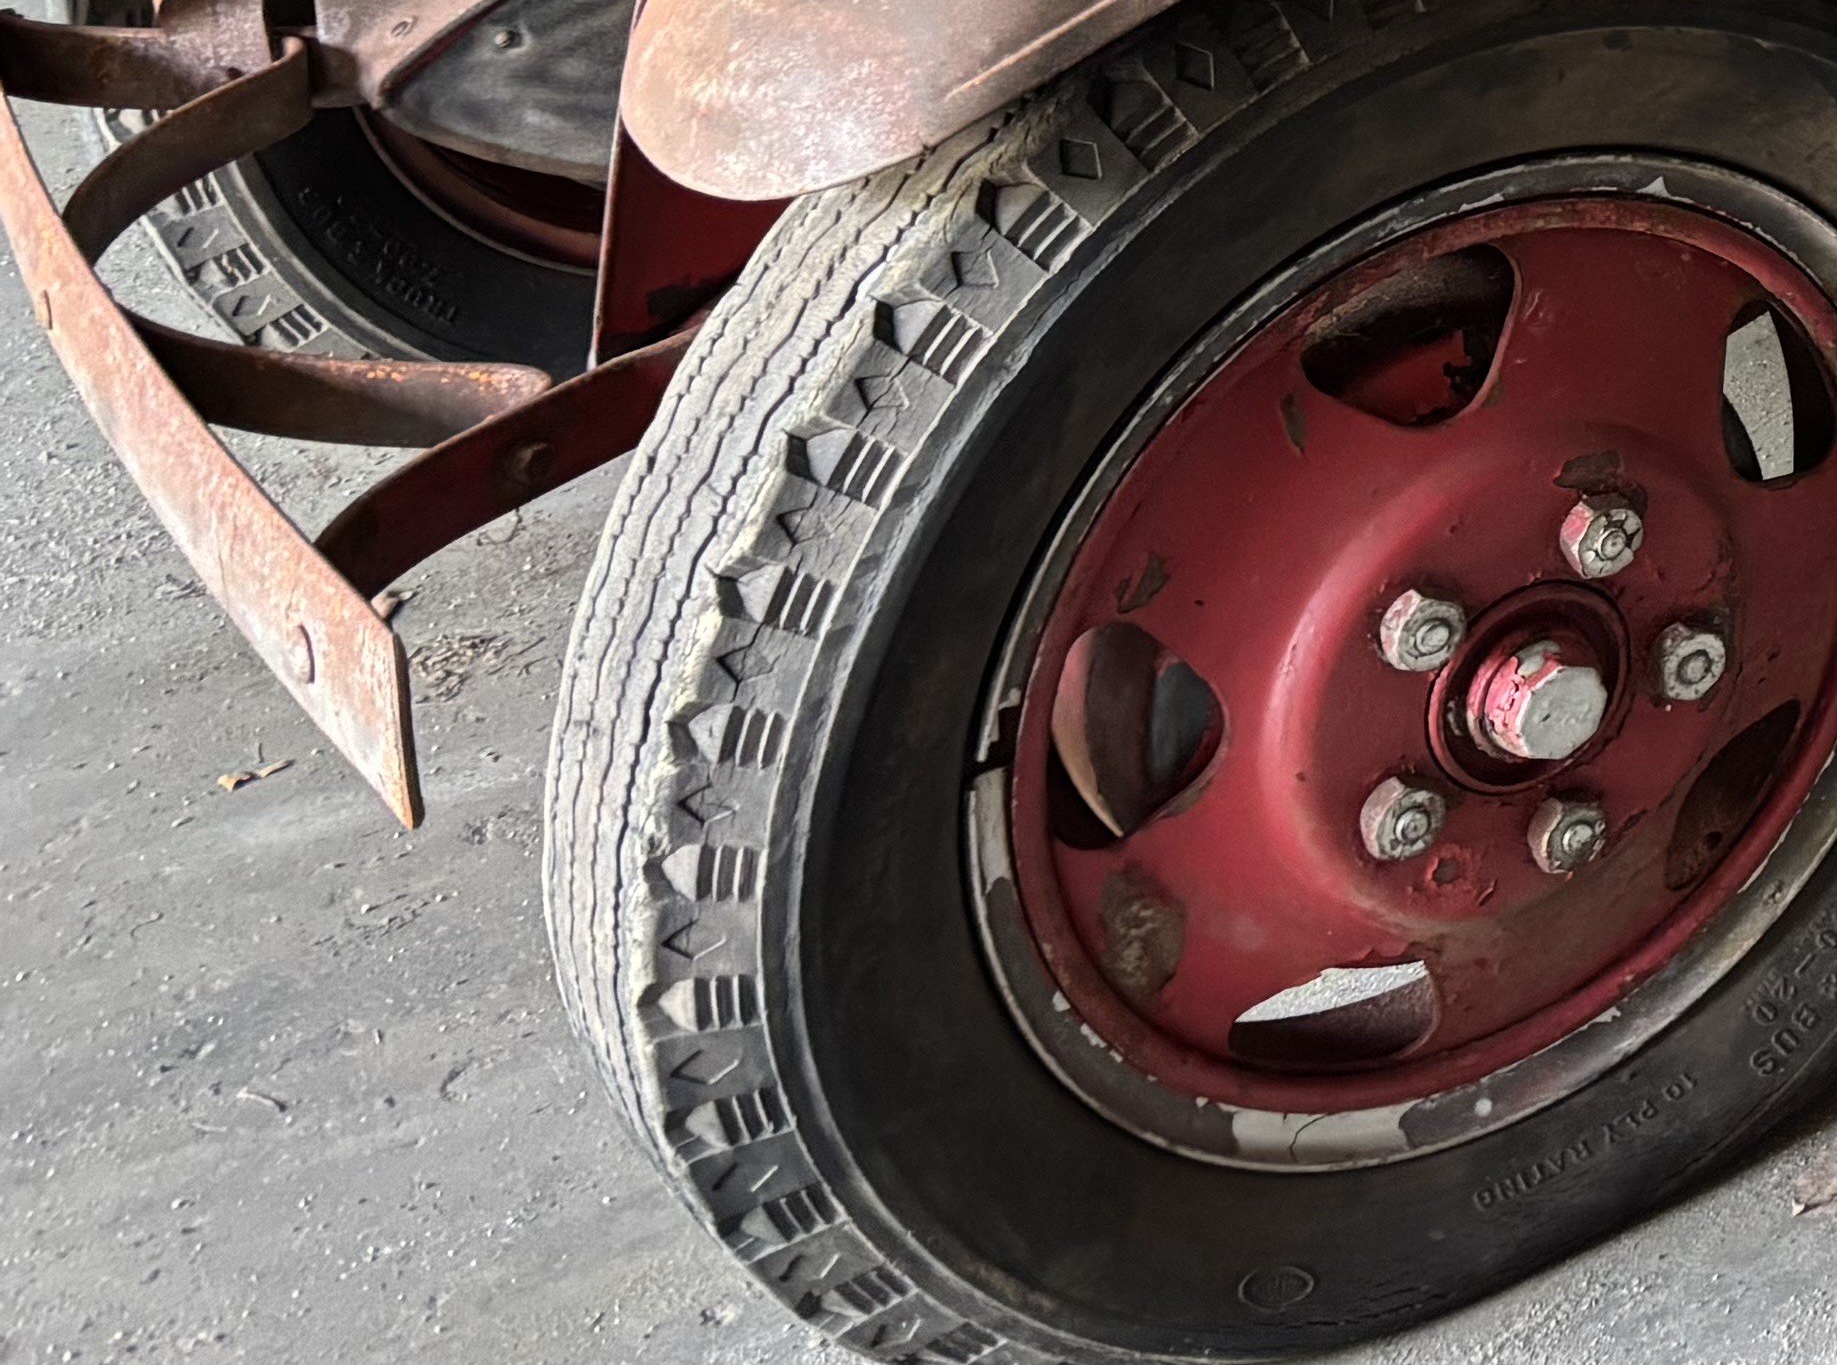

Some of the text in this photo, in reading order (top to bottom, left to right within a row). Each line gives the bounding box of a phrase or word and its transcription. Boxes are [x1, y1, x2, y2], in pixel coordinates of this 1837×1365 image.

[1750, 1002, 1820, 1077] BUS
[1472, 1071, 1699, 1212] 10 PLY RATING
